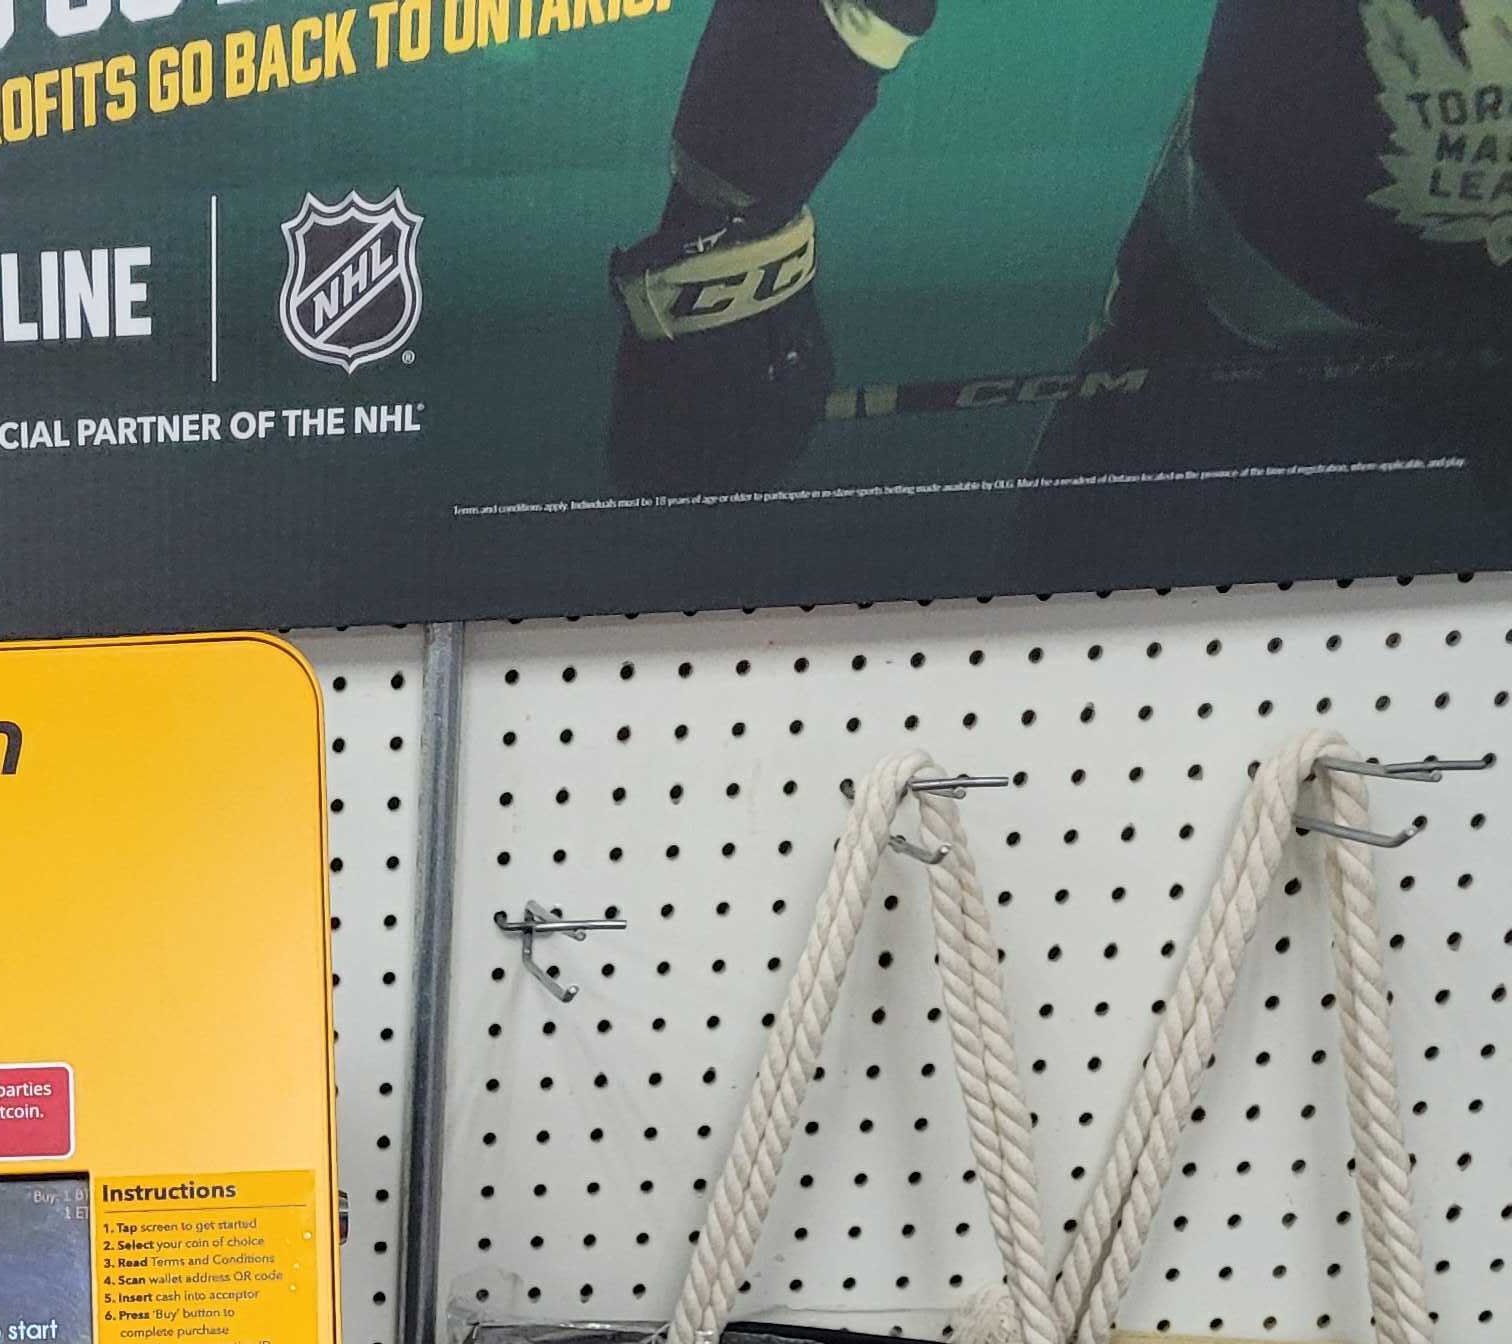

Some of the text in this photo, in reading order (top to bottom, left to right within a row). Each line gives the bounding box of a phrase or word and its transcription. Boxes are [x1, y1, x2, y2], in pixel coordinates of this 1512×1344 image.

[148, 39, 214, 114] GO
[225, 8, 358, 99] BACK
[369, 0, 432, 69] TO
[1406, 84, 1512, 130] TOR
[311, 234, 397, 333] NHL
[77, 410, 221, 447] PARTNER
[229, 410, 275, 441] OF
[282, 407, 345, 436] THE
[103, 1181, 236, 1202] Instructions
[104, 1218, 257, 1235] 1. Tap screen to get started
[104, 1237, 264, 1252] 2. Select your coin of choice
[104, 1254, 275, 1268] 3. Read Terms and Conditions
[104, 1271, 283, 1286] 4. Scan wallet address QR code
[104, 1289, 260, 1303] 5. Insert cash into acceptor
[105, 1311, 116, 1321] 6.
[119, 1311, 150, 1320] Press
[183, 1308, 220, 1318] button
[223, 1307, 235, 1317] to
[8, 1320, 57, 1341] start
[120, 1325, 229, 1338] complete purchase
